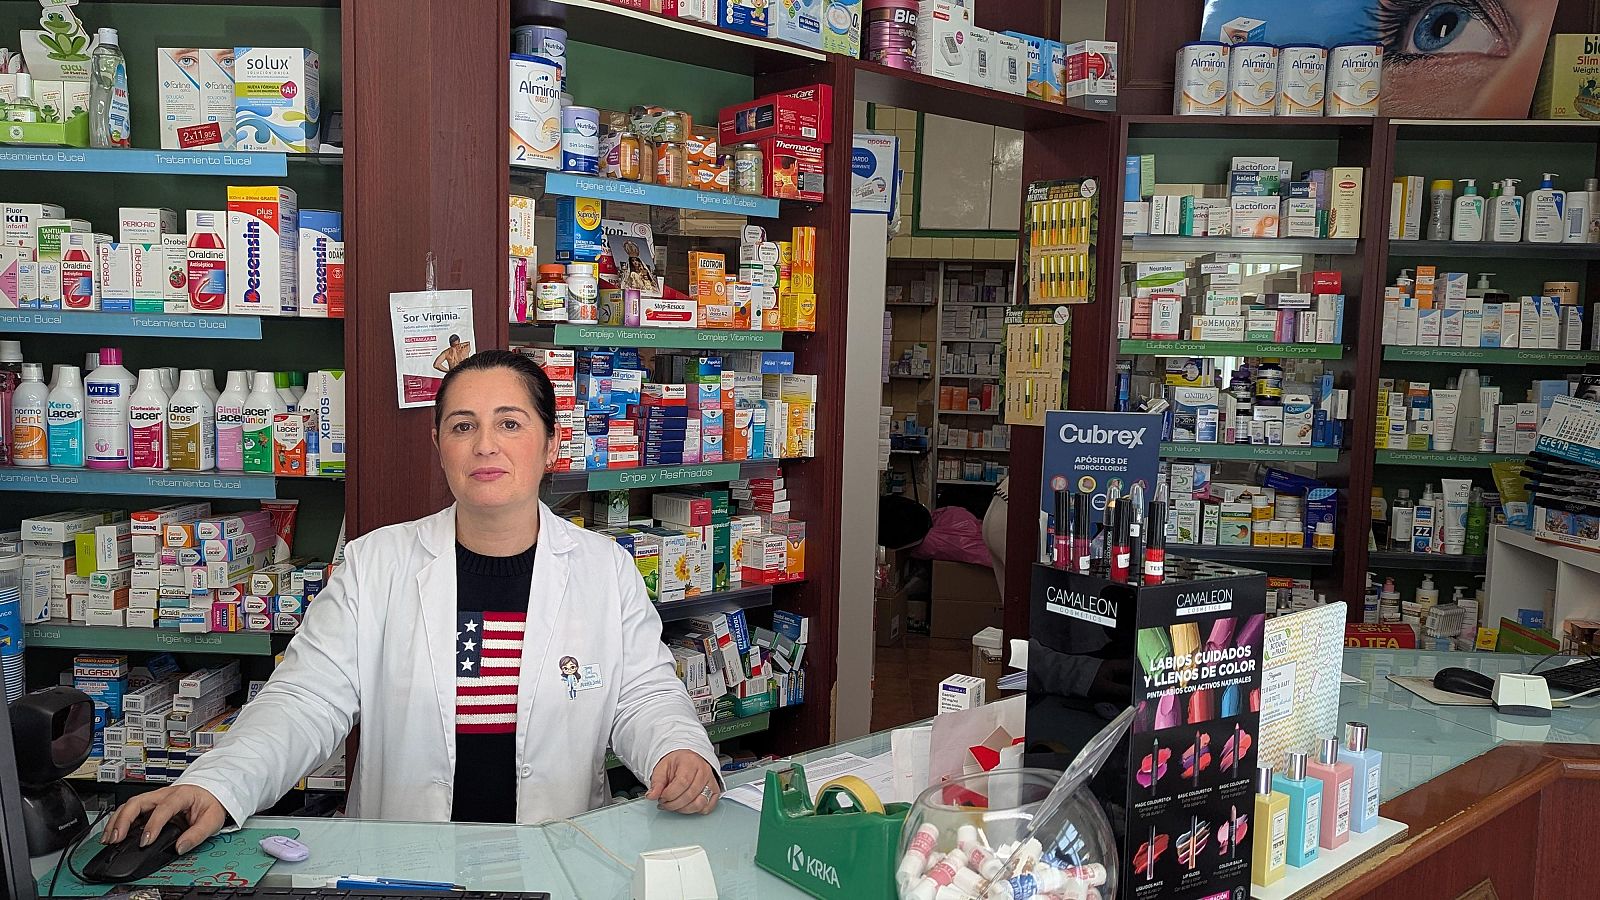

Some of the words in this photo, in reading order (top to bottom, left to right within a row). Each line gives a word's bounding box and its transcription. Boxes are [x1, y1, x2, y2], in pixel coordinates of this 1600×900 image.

[246, 55, 289, 70] solux
[1190, 58, 1226, 68] Almirón
[1241, 59, 1276, 69] Almirón
[1291, 60, 1325, 70] Almirón
[1341, 58, 1379, 69] Almirón
[1577, 55, 1599, 66] Slim
[1573, 66, 1598, 75] Weight
[519, 80, 560, 99] Almirón
[1554, 107, 1566, 115] 100
[775, 140, 823, 153] ThermaCare
[57, 152, 86, 162] Bucal
[515, 145, 527, 161] 2
[155, 155, 221, 166] Tratamiento
[224, 155, 252, 166] Bucal
[1236, 163, 1277, 172] Lactoflora
[575, 179, 604, 192] Higiene
[696, 193, 721, 205] Higiene
[256, 208, 273, 217] plus
[188, 250, 224, 259] Oraldine
[62, 262, 91, 270] Oraldine
[243, 220, 261, 303] Desensin
[700, 259, 723, 269] LEOTRON
[34, 315, 62, 324] Bucal
[131, 317, 196, 328] Tratamiento
[199, 319, 227, 329] Bucal
[402, 313, 419, 323] Sor
[422, 312, 460, 324] Virginia.
[579, 329, 614, 338] Complejo
[617, 330, 656, 340] Vitamínico
[698, 332, 729, 343] Complejo
[730, 334, 764, 342] Vitamínico
[1175, 343, 1206, 351] Corporal
[1285, 345, 1317, 353] Corporal
[1401, 349, 1430, 357] Consejo
[1431, 349, 1484, 358] Farmacéutico
[1517, 351, 1546, 360] Consejo
[88, 386, 117, 394] VITIS
[48, 401, 72, 410] Xero
[169, 404, 199, 414] Lacer
[217, 405, 241, 415] Gingi
[15, 414, 42, 424] dent
[47, 409, 81, 419] Lacer
[130, 411, 163, 420] Lacer
[169, 413, 191, 422] Oros
[321, 397, 331, 440] xeros
[276, 424, 299, 433] Lacer
[1059, 424, 1147, 449] Cubrex
[1540, 436, 1569, 451] EFETA
[1075, 455, 1115, 465] APÓSITOS
[1117, 457, 1128, 465] DE
[1074, 464, 1128, 472] HIDROCOLOIDES
[51, 474, 79, 484] Bucal
[620, 472, 647, 483] Gripe
[650, 473, 657, 483] y
[659, 468, 713, 480] Resfriados
[146, 477, 211, 488] Tratamiento
[213, 479, 242, 489] Bucal
[1046, 586, 1118, 617] CAMALEON
[1176, 589, 1233, 608] CAMALEON
[33, 630, 61, 639] Bucal
[156, 633, 192, 645] Higiene
[195, 634, 223, 645] Bucal
[1368, 637, 1399, 648] TEA
[1149, 654, 1192, 672] LABIOS
[1194, 645, 1252, 665] CUIDADOS
[75, 668, 118, 677] ALGASIV
[1143, 676, 1153, 688] Y
[1154, 668, 1199, 687] LLENOS
[1200, 666, 1217, 680] DE
[1218, 659, 1256, 677] COLOR
[1146, 687, 1184, 700] PINTALABIOS
[1184, 685, 1197, 693] CON
[1197, 680, 1220, 692] ACTIVOS
[1220, 675, 1252, 688] NATURALES
[806, 856, 842, 889] KRKA
